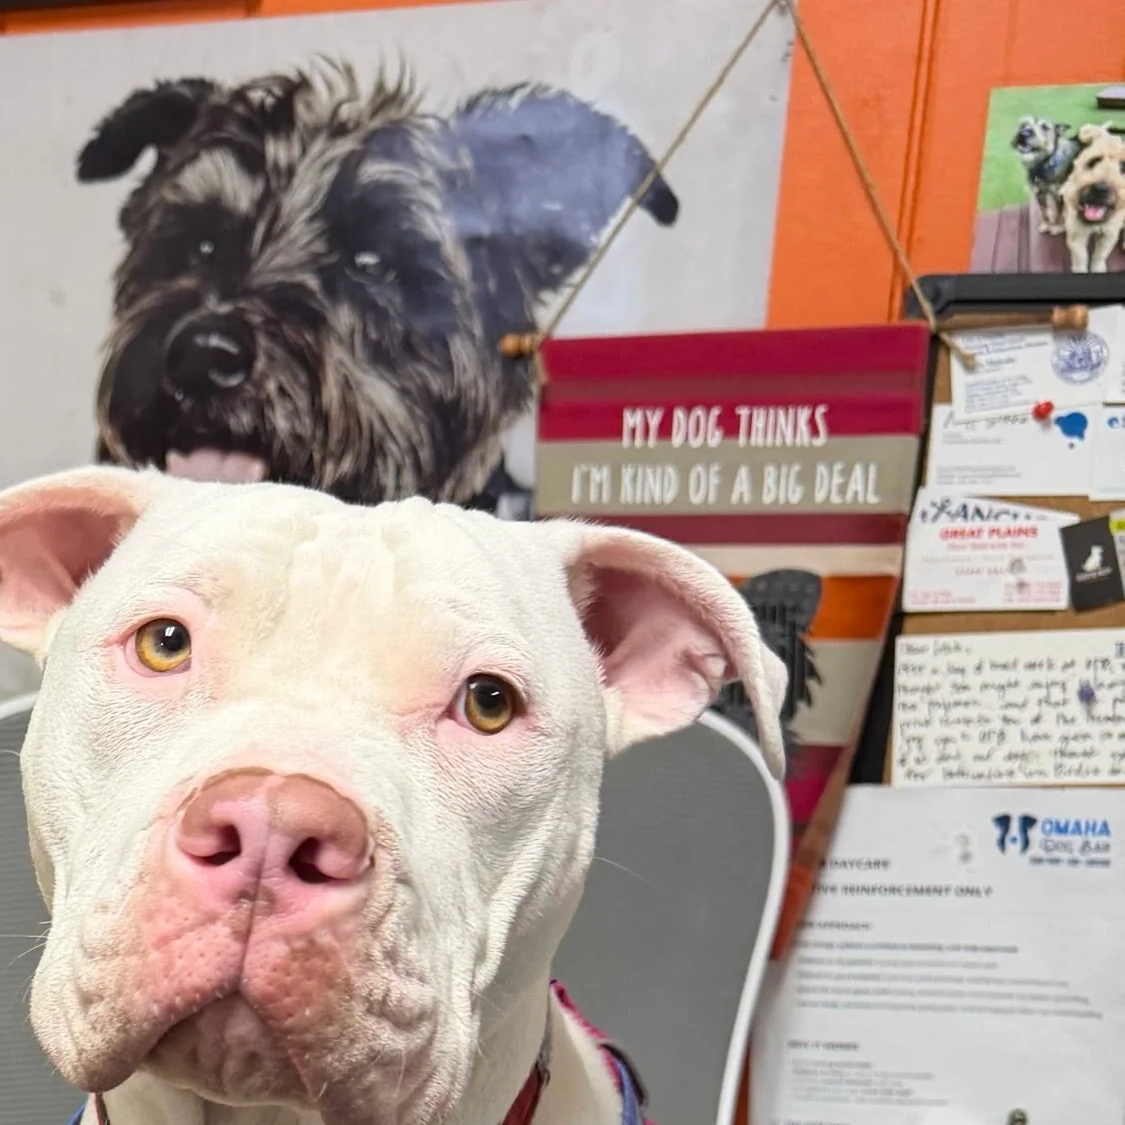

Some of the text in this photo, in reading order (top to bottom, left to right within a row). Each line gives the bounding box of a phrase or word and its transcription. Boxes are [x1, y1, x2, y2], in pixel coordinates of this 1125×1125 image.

[621, 403, 829, 449] MY DOG THINKS
[571, 462, 881, 505] I'M KIND OF A BIG DEAL
[1041, 819, 1111, 836] OMAHA
